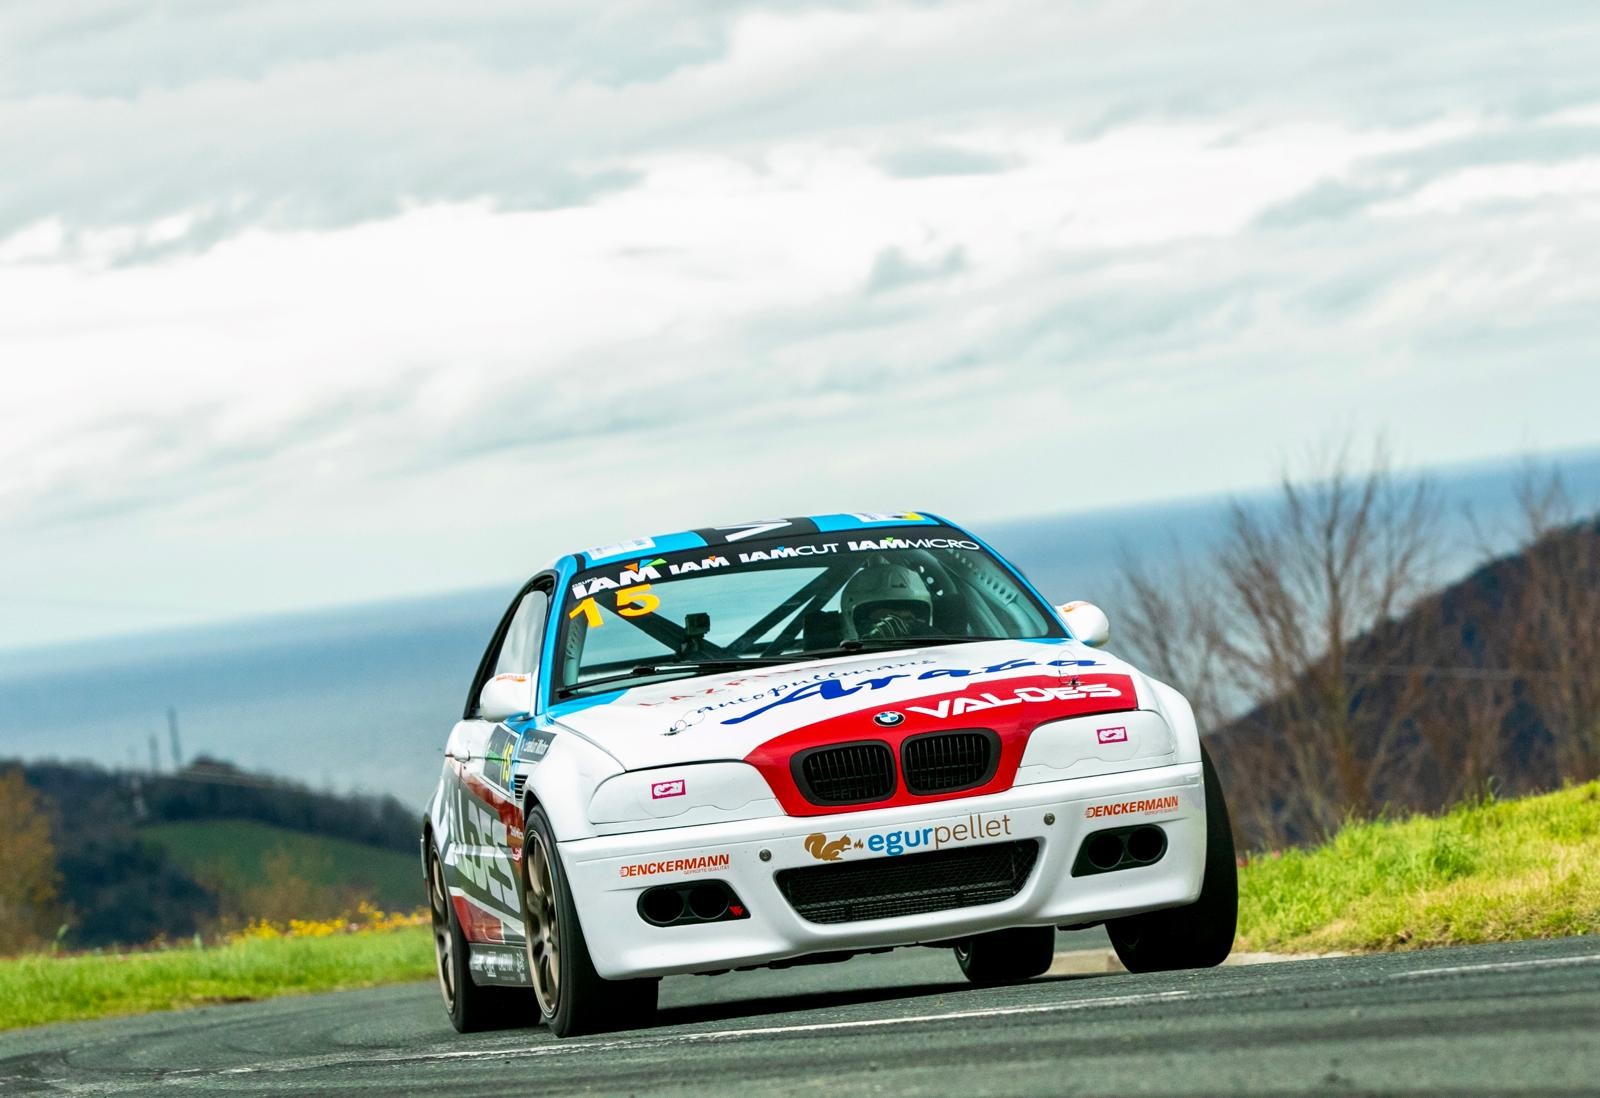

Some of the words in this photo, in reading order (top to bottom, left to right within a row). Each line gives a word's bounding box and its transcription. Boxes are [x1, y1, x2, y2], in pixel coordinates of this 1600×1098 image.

[669, 556, 731, 576] IAM
[739, 543, 839, 563] IAMCUT
[847, 538, 981, 552] IAMMICRO
[572, 565, 662, 600] IAM
[568, 583, 660, 628] 15
[719, 658, 1108, 725] Araba
[904, 683, 1122, 719] VALDES
[1085, 796, 1179, 819] DENCKERMANN
[867, 813, 1012, 857] egurpellet
[619, 853, 730, 878] DENCKERMANN
